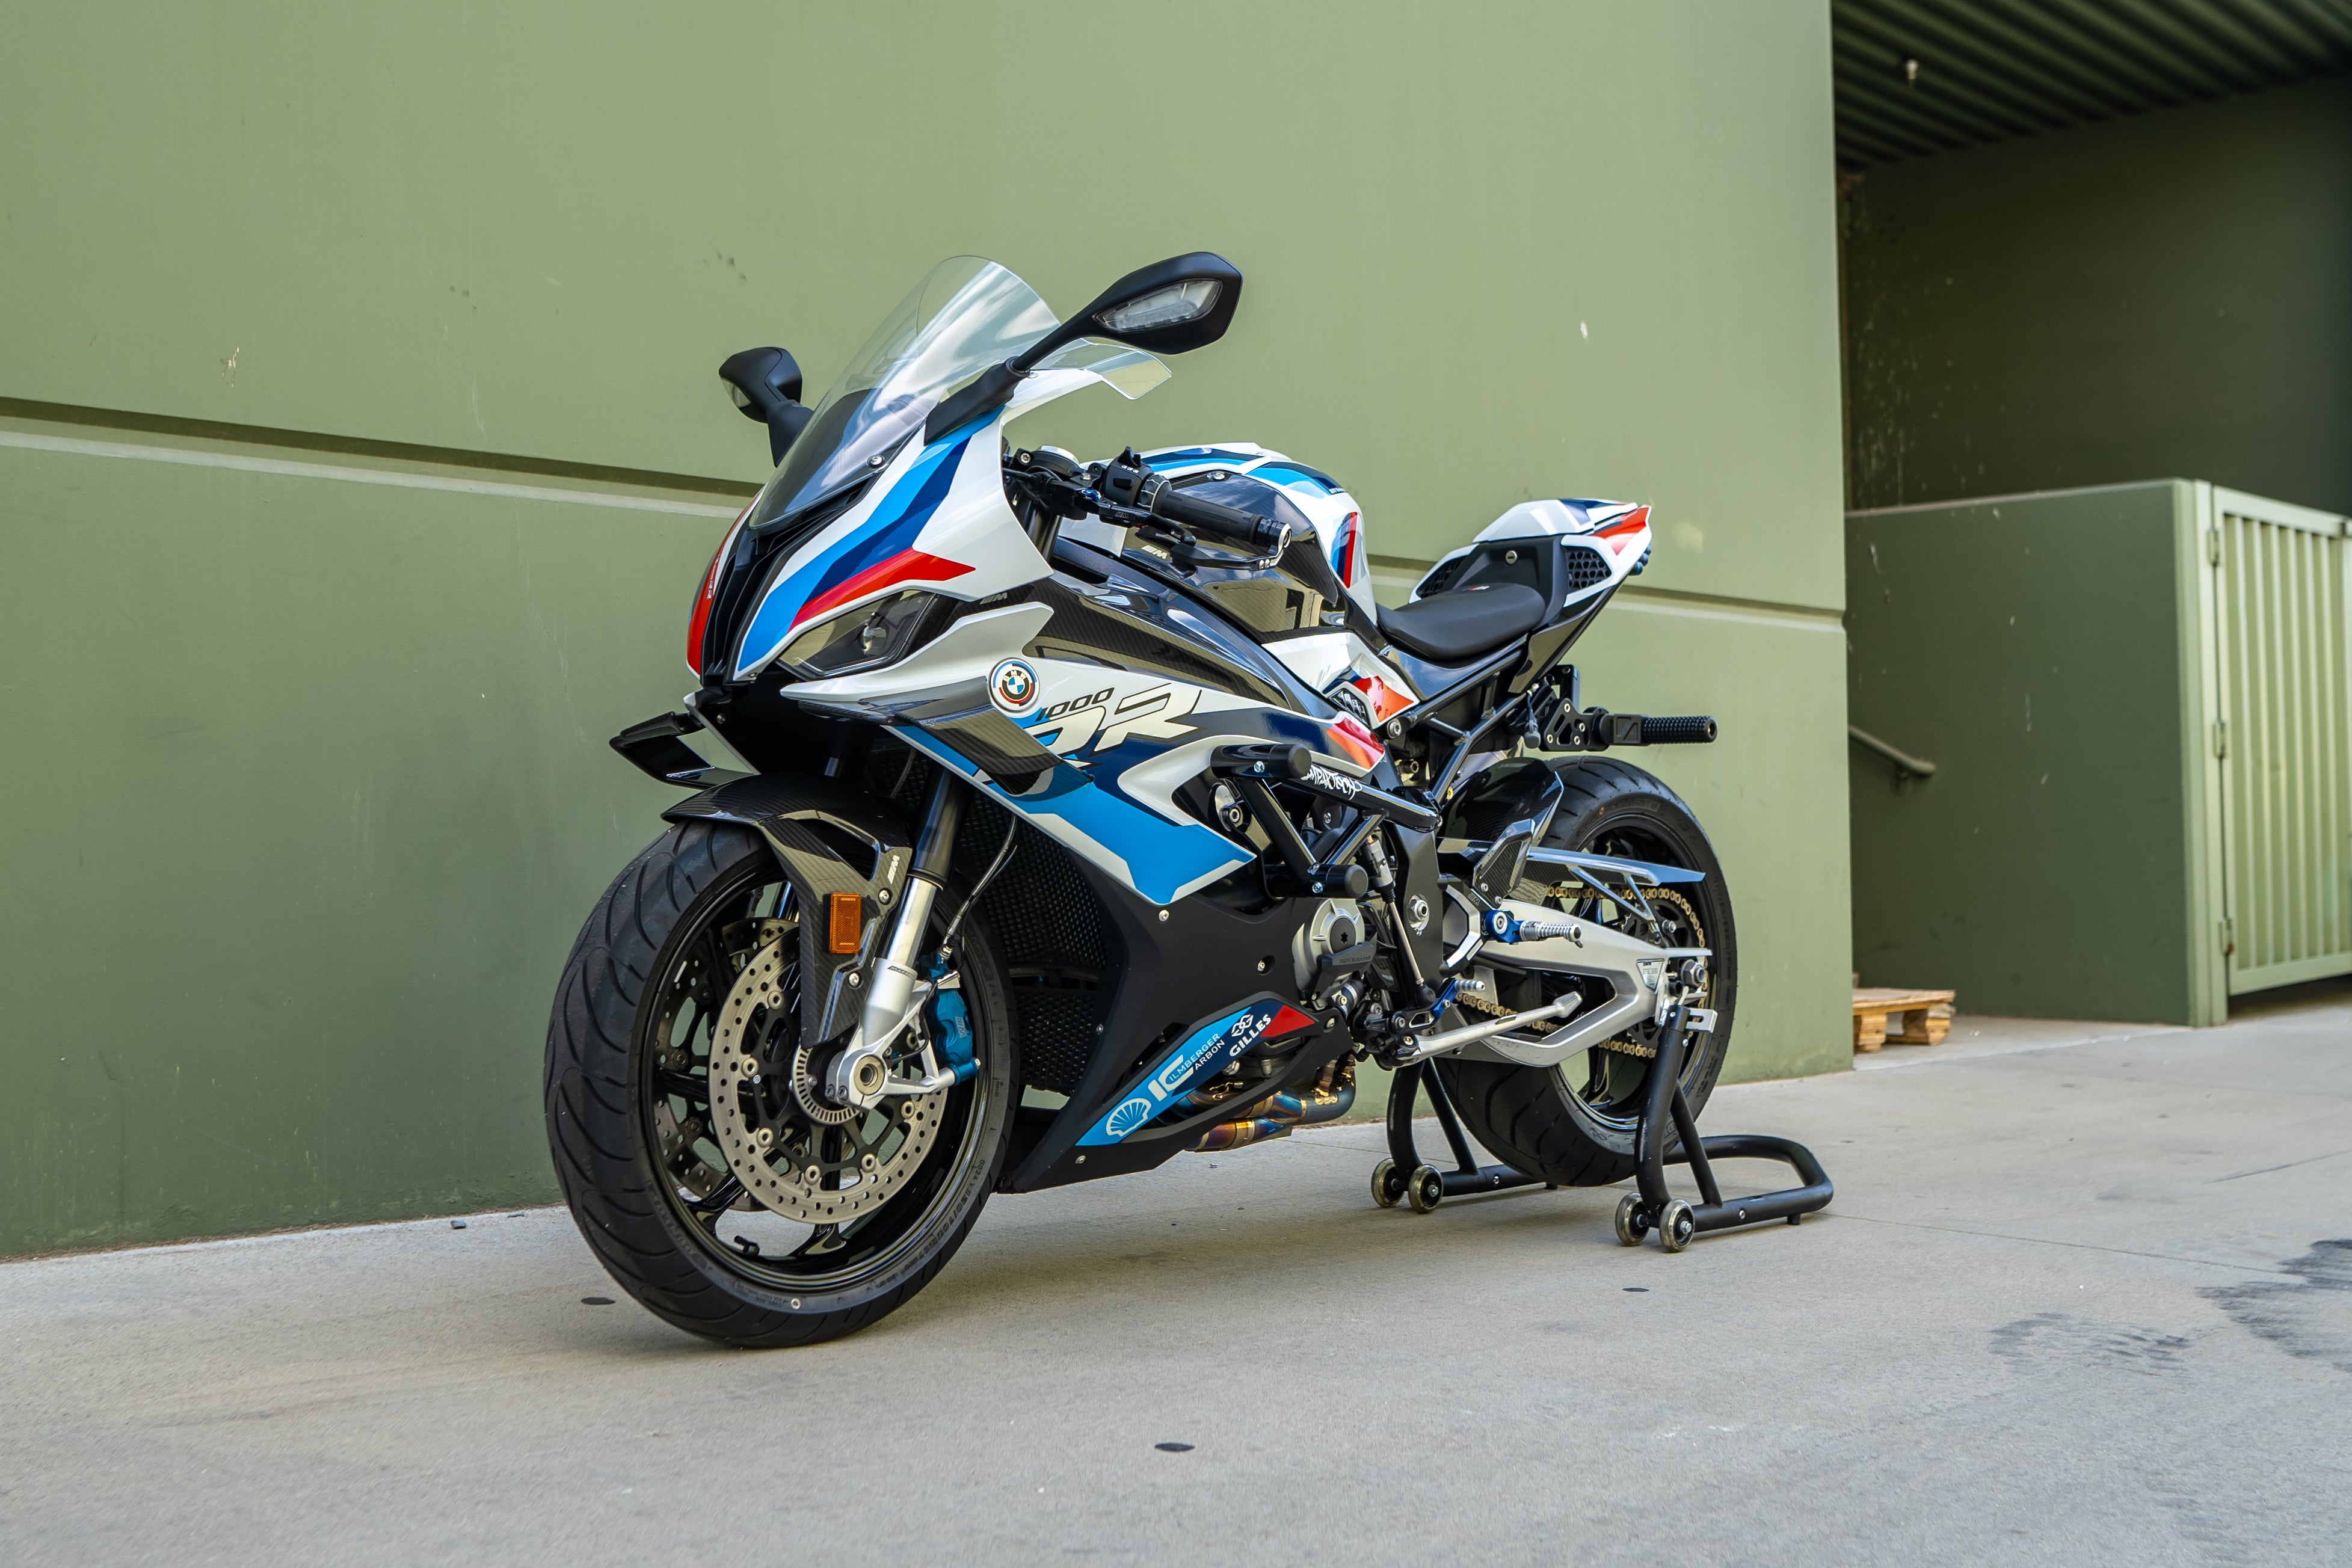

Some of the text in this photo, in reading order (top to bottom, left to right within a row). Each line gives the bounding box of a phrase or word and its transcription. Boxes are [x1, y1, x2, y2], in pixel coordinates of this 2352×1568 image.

[1003, 669, 1027, 682] BMW
[1035, 687, 1115, 722] 1000
[1229, 1013, 1272, 1057] GILLES
[1169, 1033, 1221, 1081] ILMBERGER
